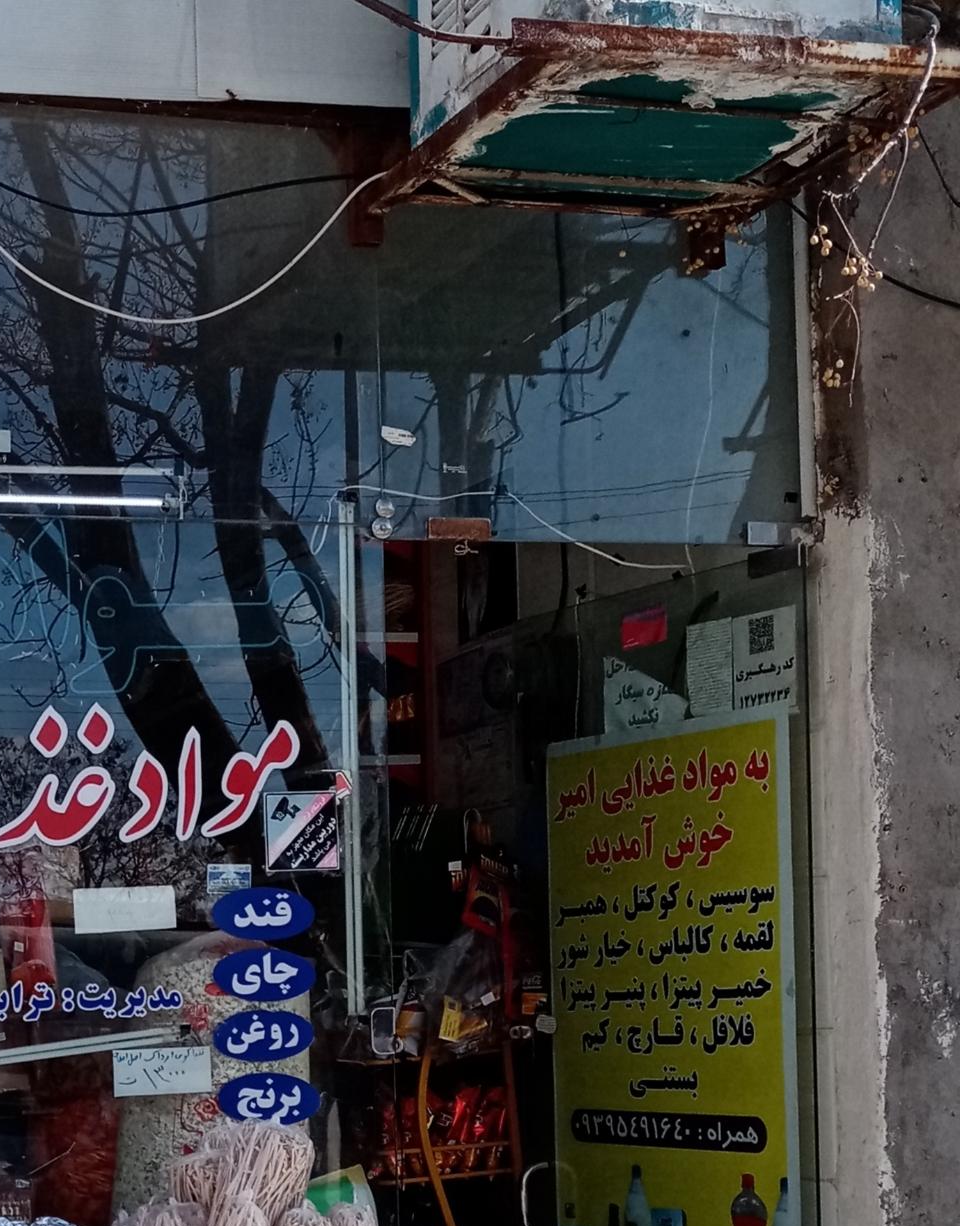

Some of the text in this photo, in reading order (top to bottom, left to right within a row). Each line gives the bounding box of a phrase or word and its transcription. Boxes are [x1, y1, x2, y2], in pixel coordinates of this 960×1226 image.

[780, 657, 794, 669] کد
[119, 719, 299, 846] مواد
[554, 747, 770, 821] به مواد غذایی امیر
[585, 810, 734, 872] خوش آمدید
[234, 893, 292, 927] قند
[554, 893, 607, 927] همبر
[555, 936, 590, 970] شور
[594, 928, 631, 969] خیار
[232, 953, 299, 995] چای
[560, 974, 596, 1012] پیتزا
[707, 967, 773, 1008] خمیر
[604, 979, 645, 1012] پنیر
[227, 1014, 299, 1053] روغن
[582, 1018, 609, 1052] کیم
[629, 1066, 699, 1099] بستنی
[237, 1078, 301, 1126] برنج
